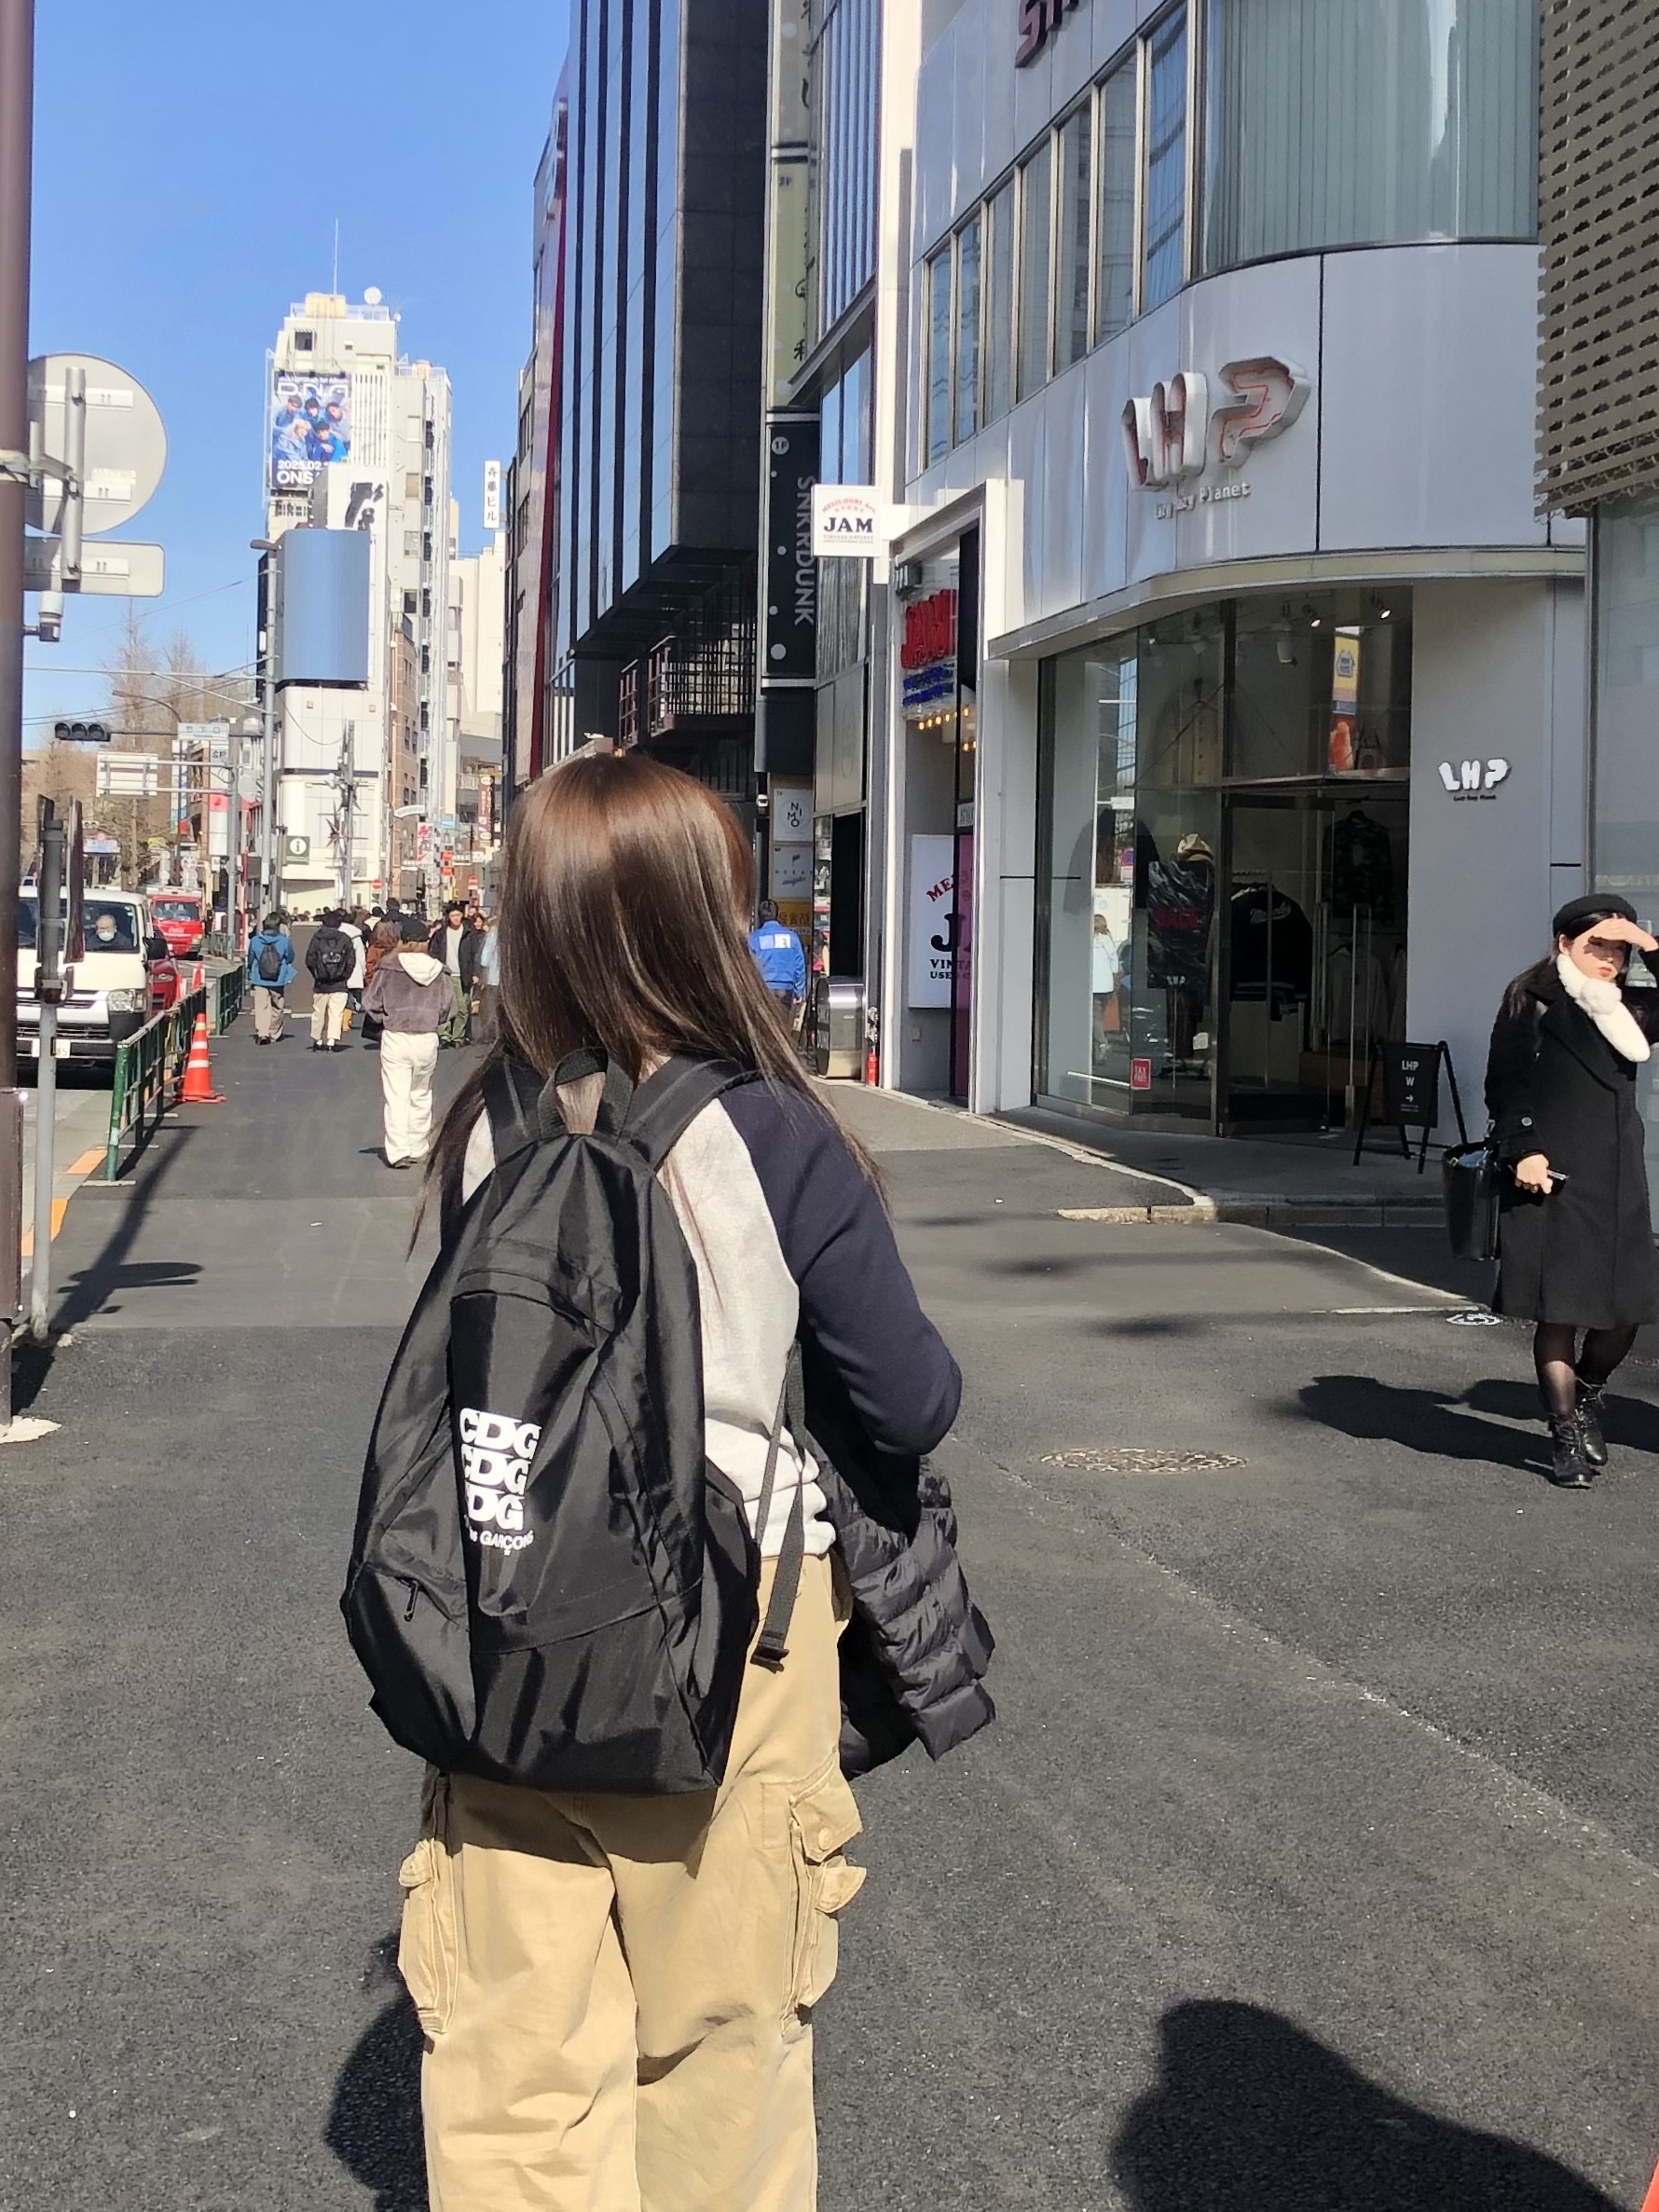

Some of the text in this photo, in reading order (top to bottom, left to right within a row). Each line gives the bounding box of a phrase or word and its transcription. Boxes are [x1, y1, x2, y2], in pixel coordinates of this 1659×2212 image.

[1199, 482, 1252, 502] Planet
[824, 516, 873, 533] JAM
[794, 474, 816, 626] SNKRDUNK
[1438, 759, 1509, 790] LHP
[1402, 1060, 1419, 1071] LHP
[1405, 1076, 1415, 1086] W
[459, 1408, 542, 1460] CDG
